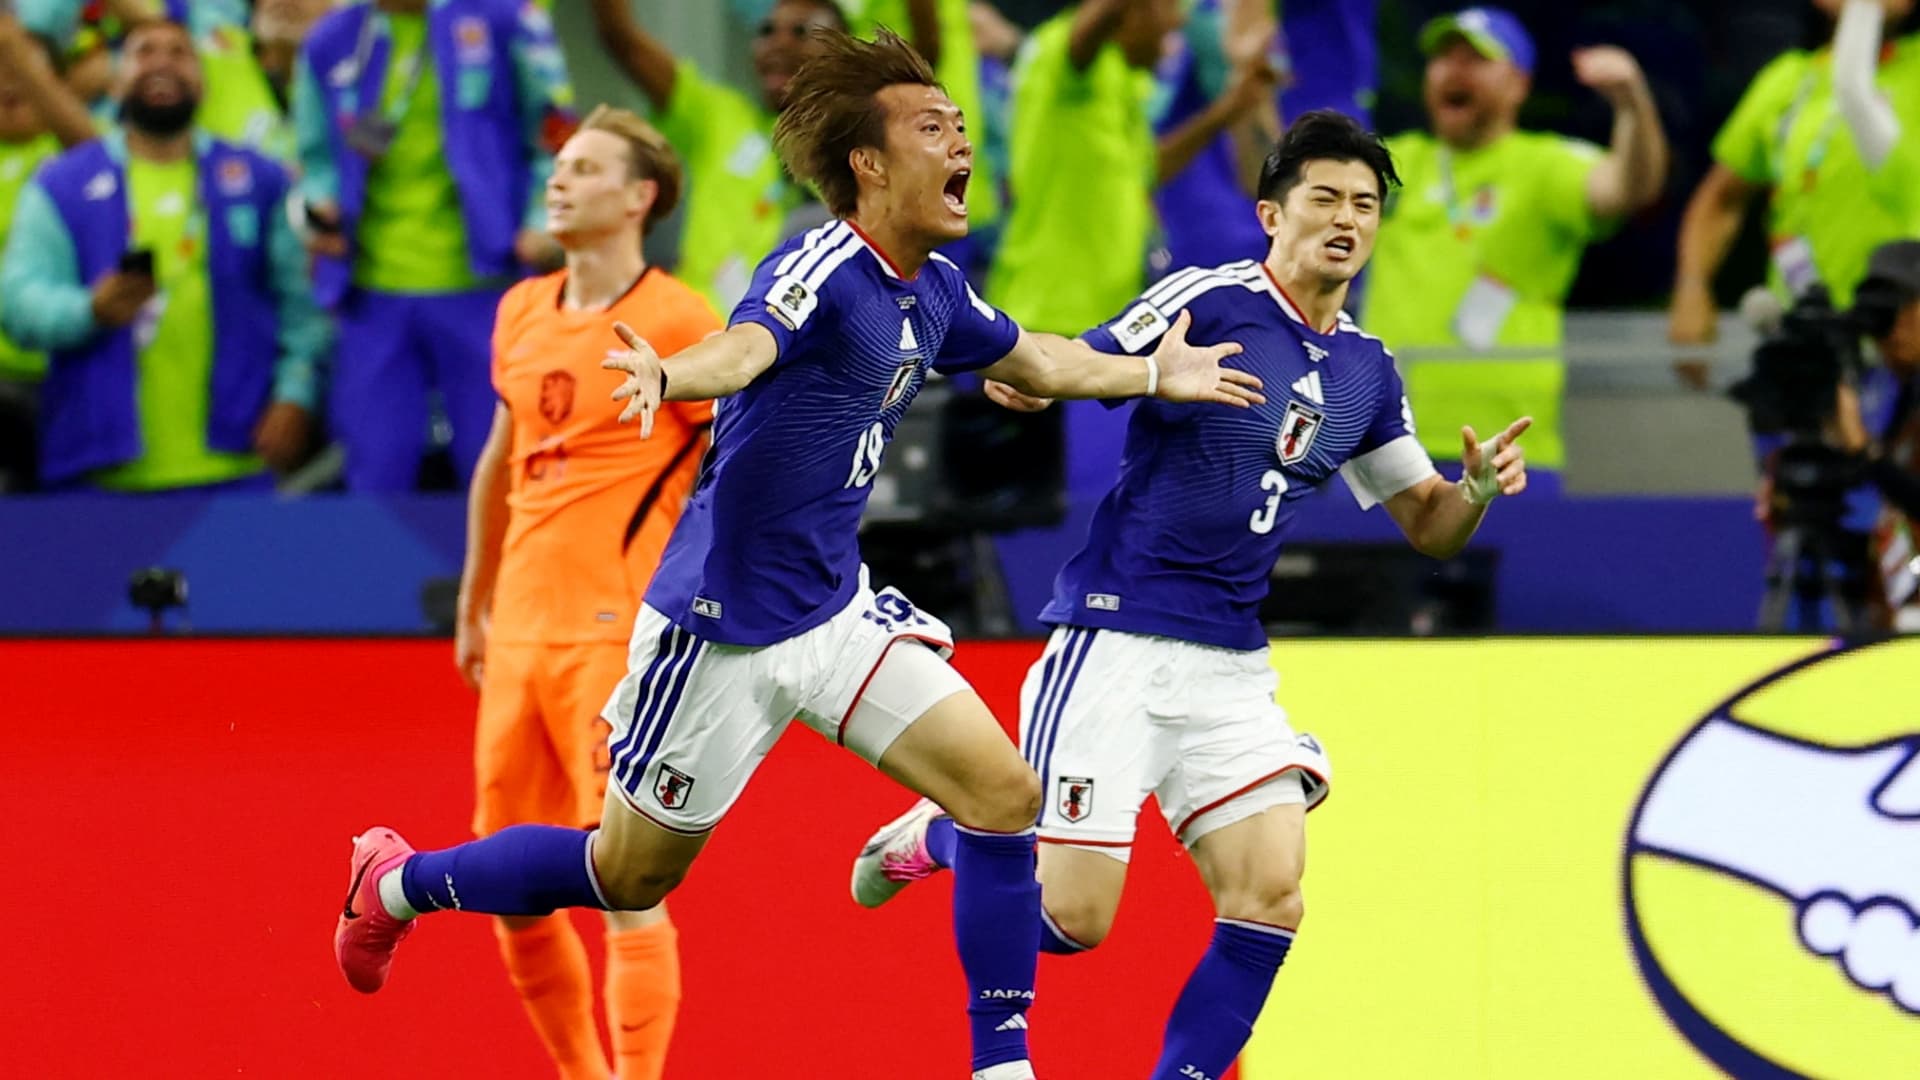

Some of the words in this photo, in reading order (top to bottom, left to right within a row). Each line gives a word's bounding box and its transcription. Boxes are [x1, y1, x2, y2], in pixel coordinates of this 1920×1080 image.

[843, 422, 884, 489] 19
[1250, 469, 1288, 534] 3
[444, 872, 462, 911] JAP
[979, 988, 1036, 999] JAPA
[1179, 1063, 1212, 1080] JA
